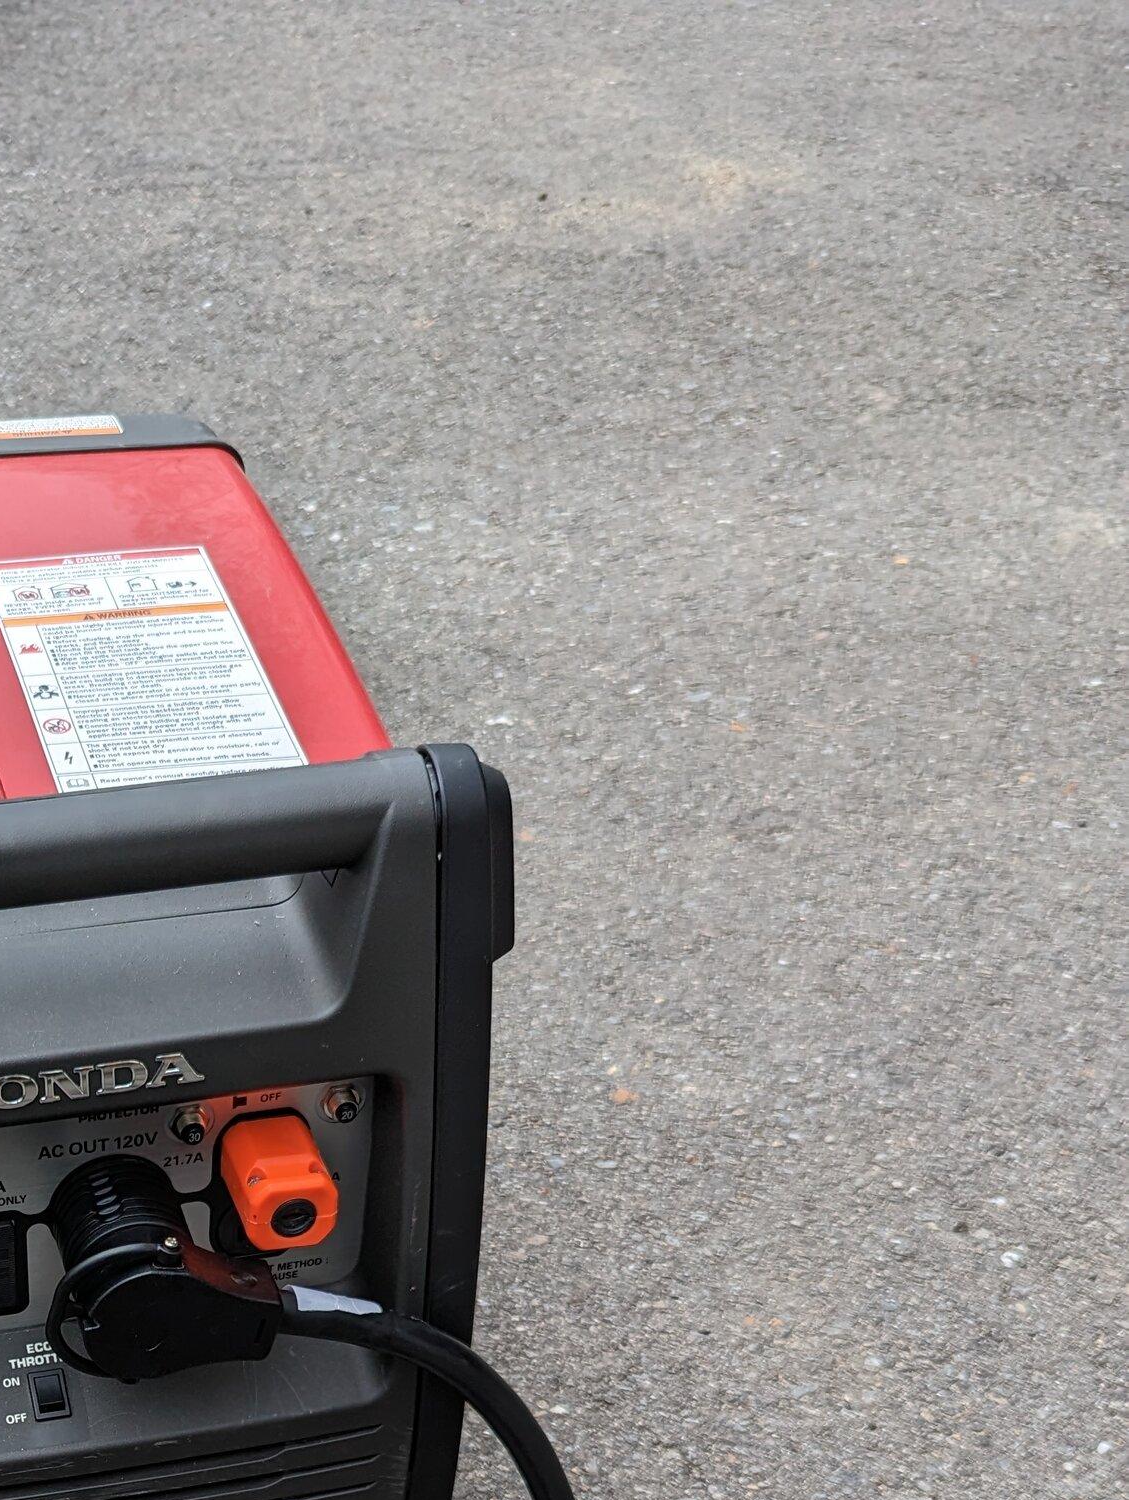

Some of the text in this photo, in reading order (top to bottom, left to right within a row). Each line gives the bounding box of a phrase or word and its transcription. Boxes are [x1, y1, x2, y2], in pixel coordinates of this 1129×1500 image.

[76, 555, 121, 565] DANGER
[96, 609, 152, 619] WARNING
[260, 1092, 282, 1103] OFF
[78, 1105, 160, 1123] PROTECTOR
[342, 1110, 353, 1120] 20
[188, 1132, 201, 1142] 30
[38, 1132, 158, 1160] AC OUT 120V
[163, 1152, 204, 1168] 21.7A
[278, 1258, 322, 1272] METHOD
[2, 1377, 20, 1388] ON
[6, 1412, 27, 1424] OFF
